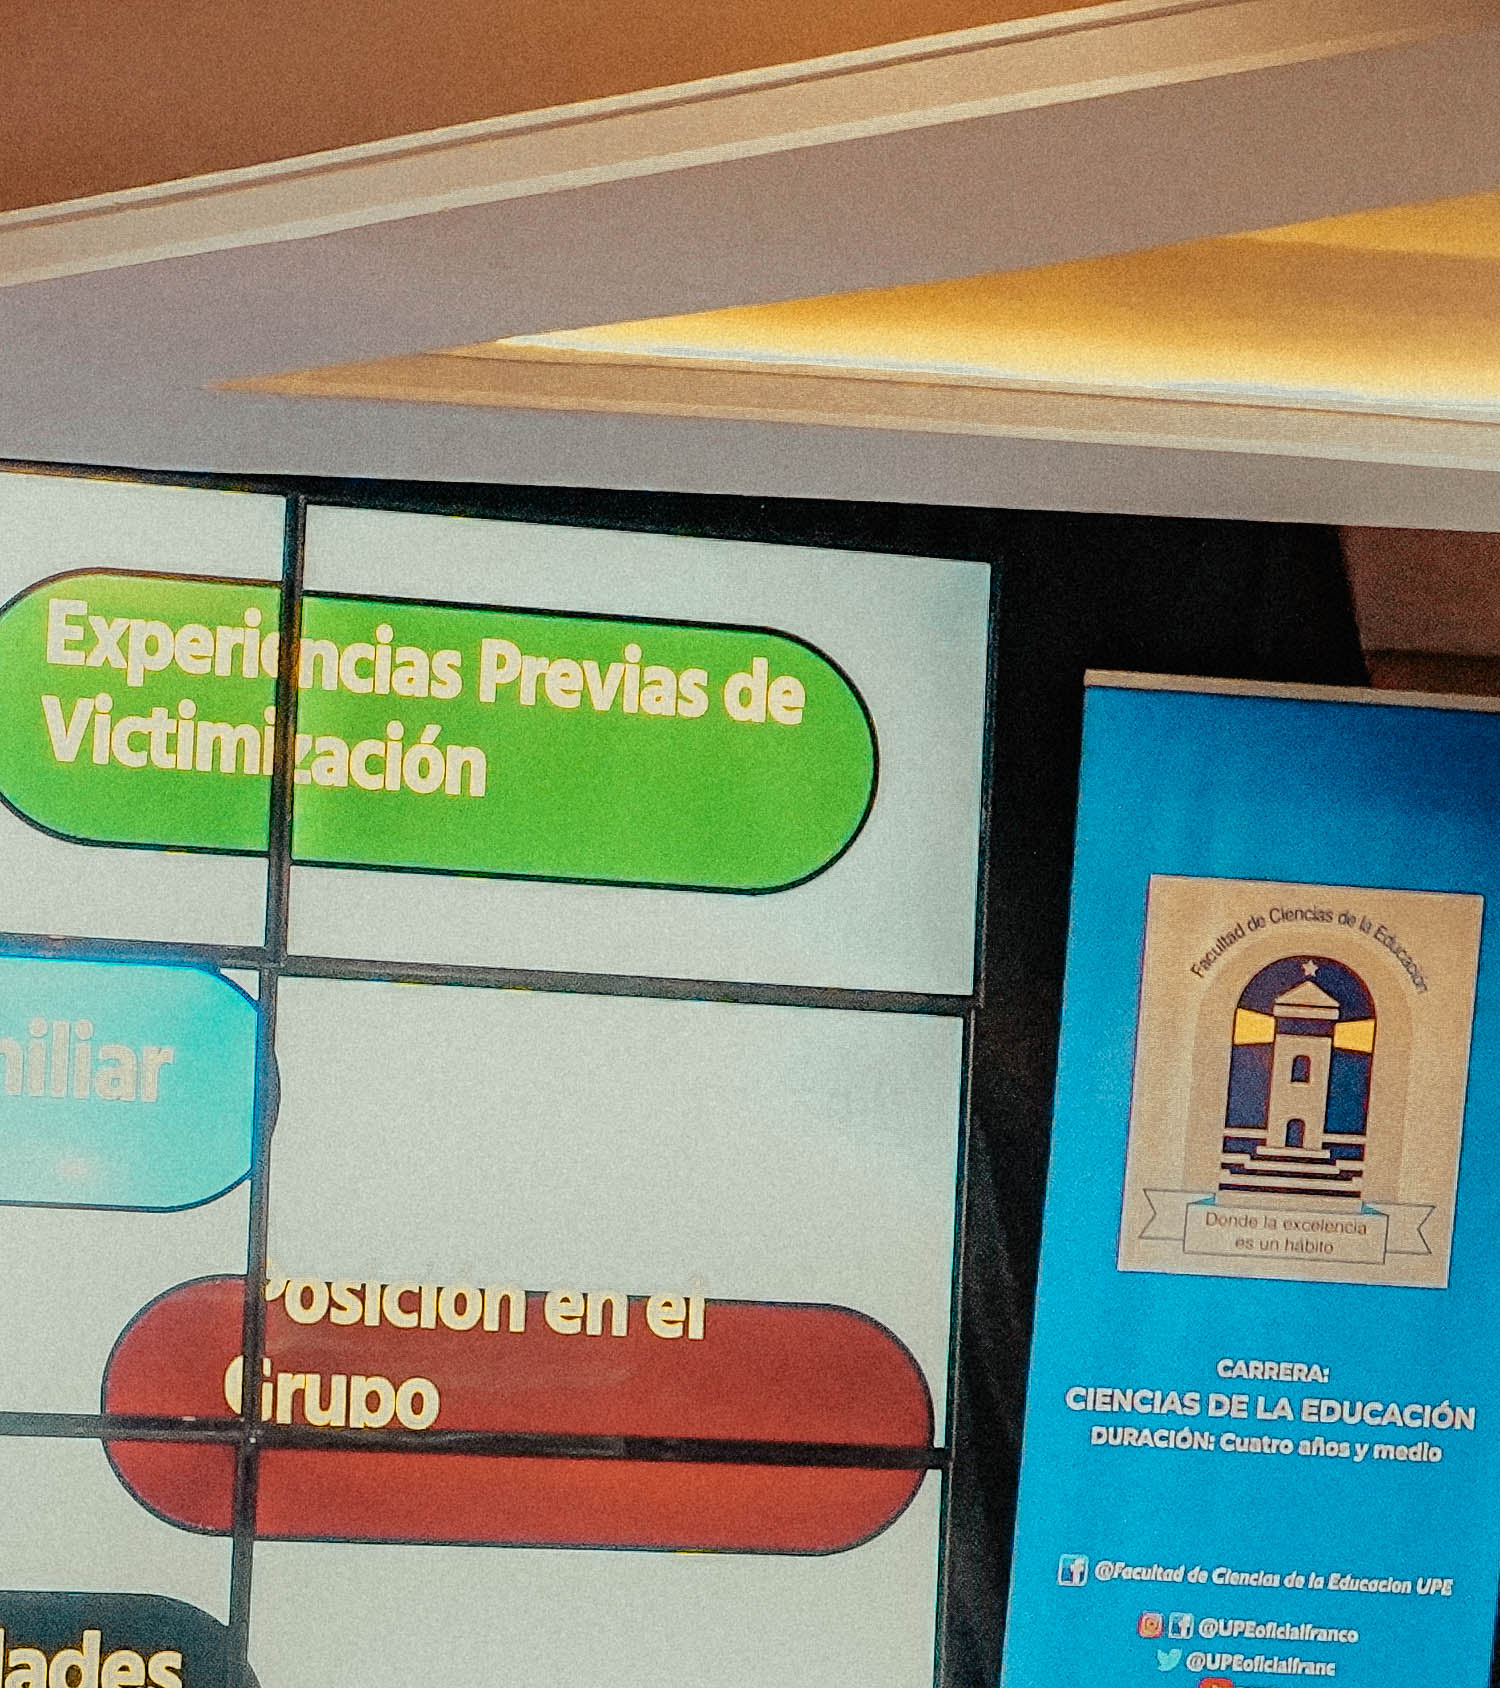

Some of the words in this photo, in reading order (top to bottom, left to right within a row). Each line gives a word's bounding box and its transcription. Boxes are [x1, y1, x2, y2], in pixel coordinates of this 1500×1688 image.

[480, 638, 707, 720] Previas
[723, 657, 805, 726] de
[1190, 923, 1246, 978] Facultad
[1248, 916, 1266, 932] de
[1269, 907, 1333, 924] Ciencias
[1338, 911, 1356, 926] de
[1360, 915, 1372, 933] la
[1206, 1211, 1258, 1229] Donde
[1264, 1215, 1277, 1230] la
[1283, 1219, 1367, 1235] excelencia
[1235, 1239, 1254, 1250] es
[1260, 1240, 1279, 1251] un
[544, 1288, 628, 1336] en
[646, 1272, 705, 1340] el
[1217, 1358, 1330, 1383] CARRERA:
[1065, 1386, 1201, 1417] CIENCIAS
[1207, 1392, 1248, 1418] DE
[1256, 1396, 1294, 1421] LA
[1301, 1398, 1477, 1431] EDUCACIÓN
[1090, 1425, 1215, 1451] DURACIÓN:
[1220, 1433, 1294, 1456] Cuatro
[1298, 1435, 1349, 1458] años
[1353, 1442, 1369, 1463] y
[1373, 1441, 1443, 1463] medio
[1094, 1561, 1185, 1583] @Facultad
[1187, 1565, 1207, 1584] de
[1212, 1567, 1279, 1589] Ciencias
[1283, 1570, 1305, 1589] de
[1307, 1572, 1326, 1590] la
[1328, 1573, 1412, 1595] Educacion
[1416, 1577, 1454, 1597] UPE
[1199, 1617, 1360, 1643] @UPEoficialfranco
